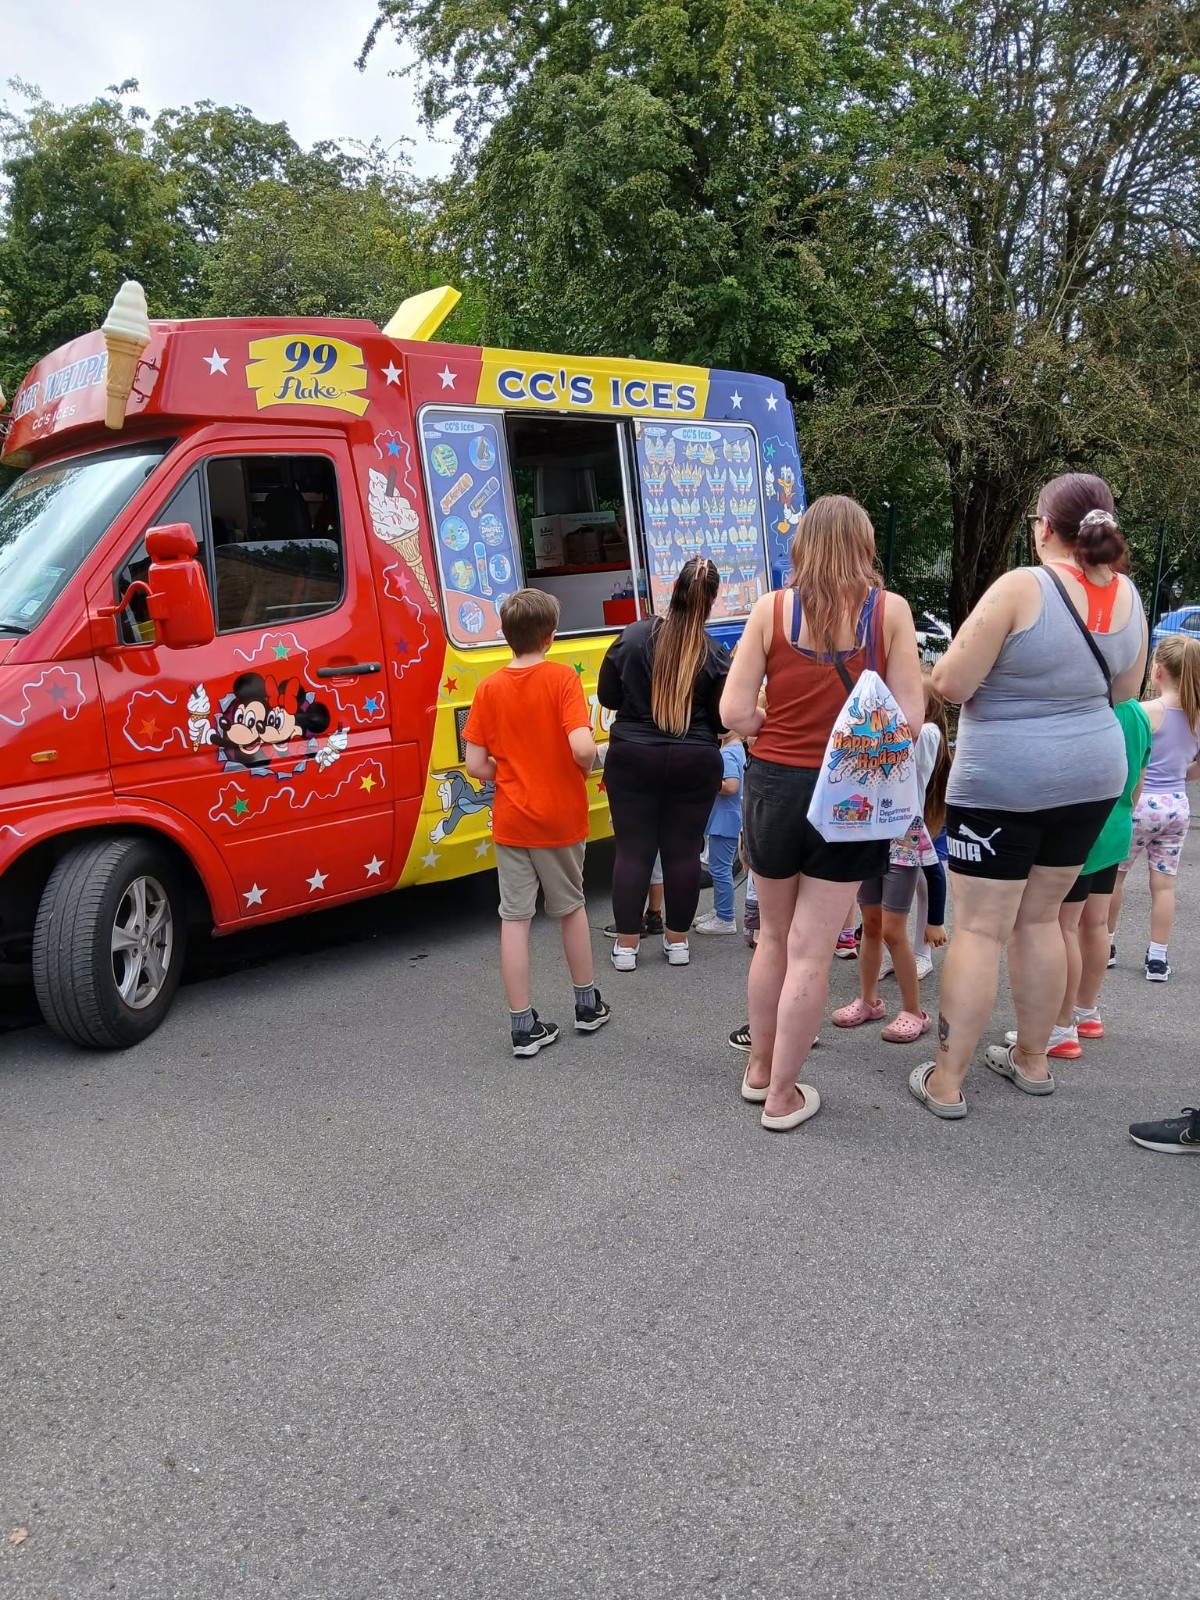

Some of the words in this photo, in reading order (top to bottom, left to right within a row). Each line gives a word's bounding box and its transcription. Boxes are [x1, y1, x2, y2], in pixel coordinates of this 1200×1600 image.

[282, 341, 338, 375] 99
[15, 381, 40, 420] MR
[43, 352, 108, 404] WHIPP
[497, 368, 594, 406] CC'S
[609, 376, 697, 411] ICES
[32, 412, 52, 431] CC'S
[52, 404, 77, 421] ICES
[833, 730, 879, 753] Happy
[857, 747, 909, 769] Hodays
[879, 806, 911, 818] Department
[879, 816, 888, 824] for
[946, 835, 982, 862] UMA
